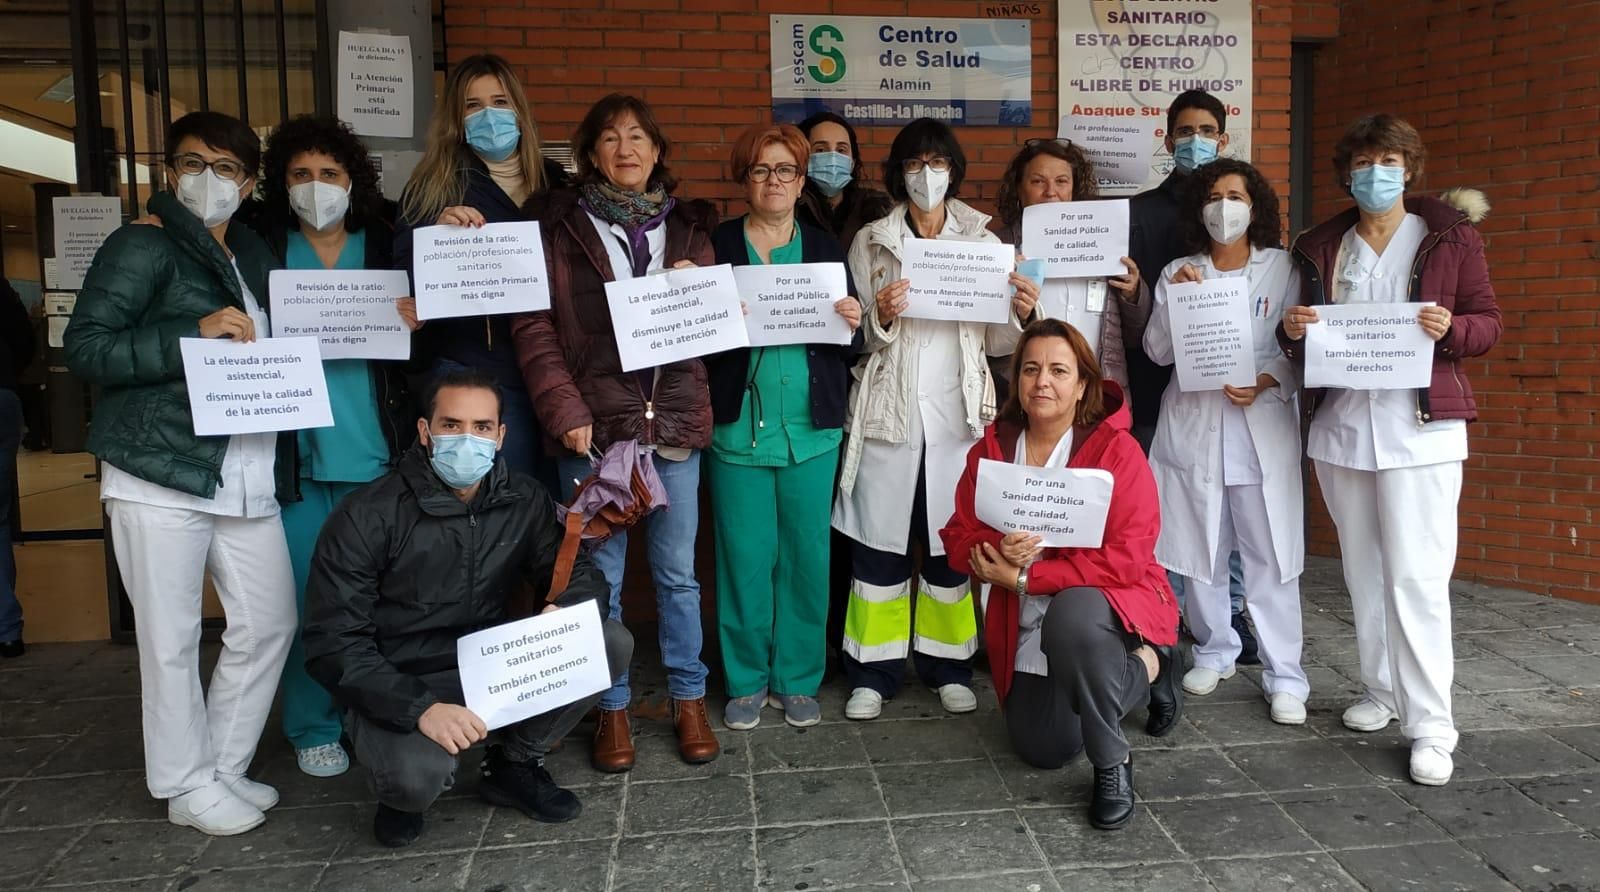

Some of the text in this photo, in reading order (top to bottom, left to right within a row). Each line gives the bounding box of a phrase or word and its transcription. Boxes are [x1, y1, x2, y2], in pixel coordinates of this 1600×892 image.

[1107, 11, 1206, 24] SANITARIO
[879, 25, 958, 44] Centro
[1075, 34, 1237, 47] ESTA DECLARADO
[348, 45, 380, 53] HUELGA
[793, 23, 804, 84] sescam
[879, 50, 981, 68] de Salud
[1120, 56, 1195, 69] CENTRO
[350, 72, 403, 83] La Atención
[356, 84, 395, 93] Primaria
[1070, 79, 1132, 92] “LIBRE
[1139, 80, 1163, 92] DE
[368, 96, 385, 104] está
[354, 107, 400, 116] masificada
[844, 103, 963, 119] Castilla-La Mancha
[1141, 106, 1160, 116] su
[1088, 125, 1140, 135] profesionales
[1086, 135, 1123, 143] sanitarios
[1103, 150, 1136, 158] tenemos
[1044, 226, 1109, 235] Sanidad Pública
[434, 237, 470, 246] Revisión
[1067, 240, 1098, 249] calidad,
[424, 246, 533, 263] población/profesionales
[924, 251, 955, 259] Revisión
[1061, 254, 1104, 262] masificada
[457, 262, 502, 271] sanitarios
[912, 262, 1005, 273] población/profesionales
[460, 278, 499, 288] Atención
[502, 276, 538, 284] Primaria
[776, 277, 791, 285] Por
[939, 275, 976, 283] sanitarios
[296, 283, 335, 291] Revisión
[337, 283, 348, 291] de
[351, 283, 359, 291] la
[628, 280, 717, 304] La elevada presión
[461, 291, 505, 300] más digna
[758, 291, 830, 301] Sanidad Pública
[939, 289, 972, 297] Atención
[973, 291, 1003, 299] Primaria
[1177, 293, 1212, 303] HUELGA
[283, 295, 399, 305] población/profesionale
[954, 300, 974, 308] digna
[650, 297, 703, 315] asistencial,
[1197, 301, 1229, 310] diciembre
[770, 307, 819, 316] de calidad,
[631, 310, 729, 338] disminuye la calidad
[778, 320, 826, 329] masificada
[1196, 321, 1224, 330] personal
[1327, 316, 1416, 328] Los profesionales
[284, 326, 299, 334] Por
[322, 325, 362, 333] Atención
[364, 324, 401, 332] Primaria
[321, 336, 366, 344] más digna
[650, 341, 662, 349] de
[676, 328, 717, 344] atención
[1345, 331, 1396, 340] sanitarios
[1205, 337, 1231, 345] paraliza
[1184, 347, 1208, 357] jornada
[1325, 349, 1416, 358] también tenemos
[204, 354, 302, 366] La elevada presión
[1346, 363, 1393, 372] derechos
[226, 370, 285, 380] asistencial,
[206, 388, 312, 402] disminuye la calidad
[225, 405, 299, 417] de la atención
[1025, 478, 1066, 489] Por una
[1002, 491, 1084, 506] Sanidad Pública
[1013, 507, 1069, 520] de calidad,
[1002, 521, 1074, 534] no masificada
[481, 621, 581, 656] Los profesionales
[506, 644, 563, 668] sanitarios
[488, 655, 588, 695] también tenemos
[517, 678, 568, 702] derechos
